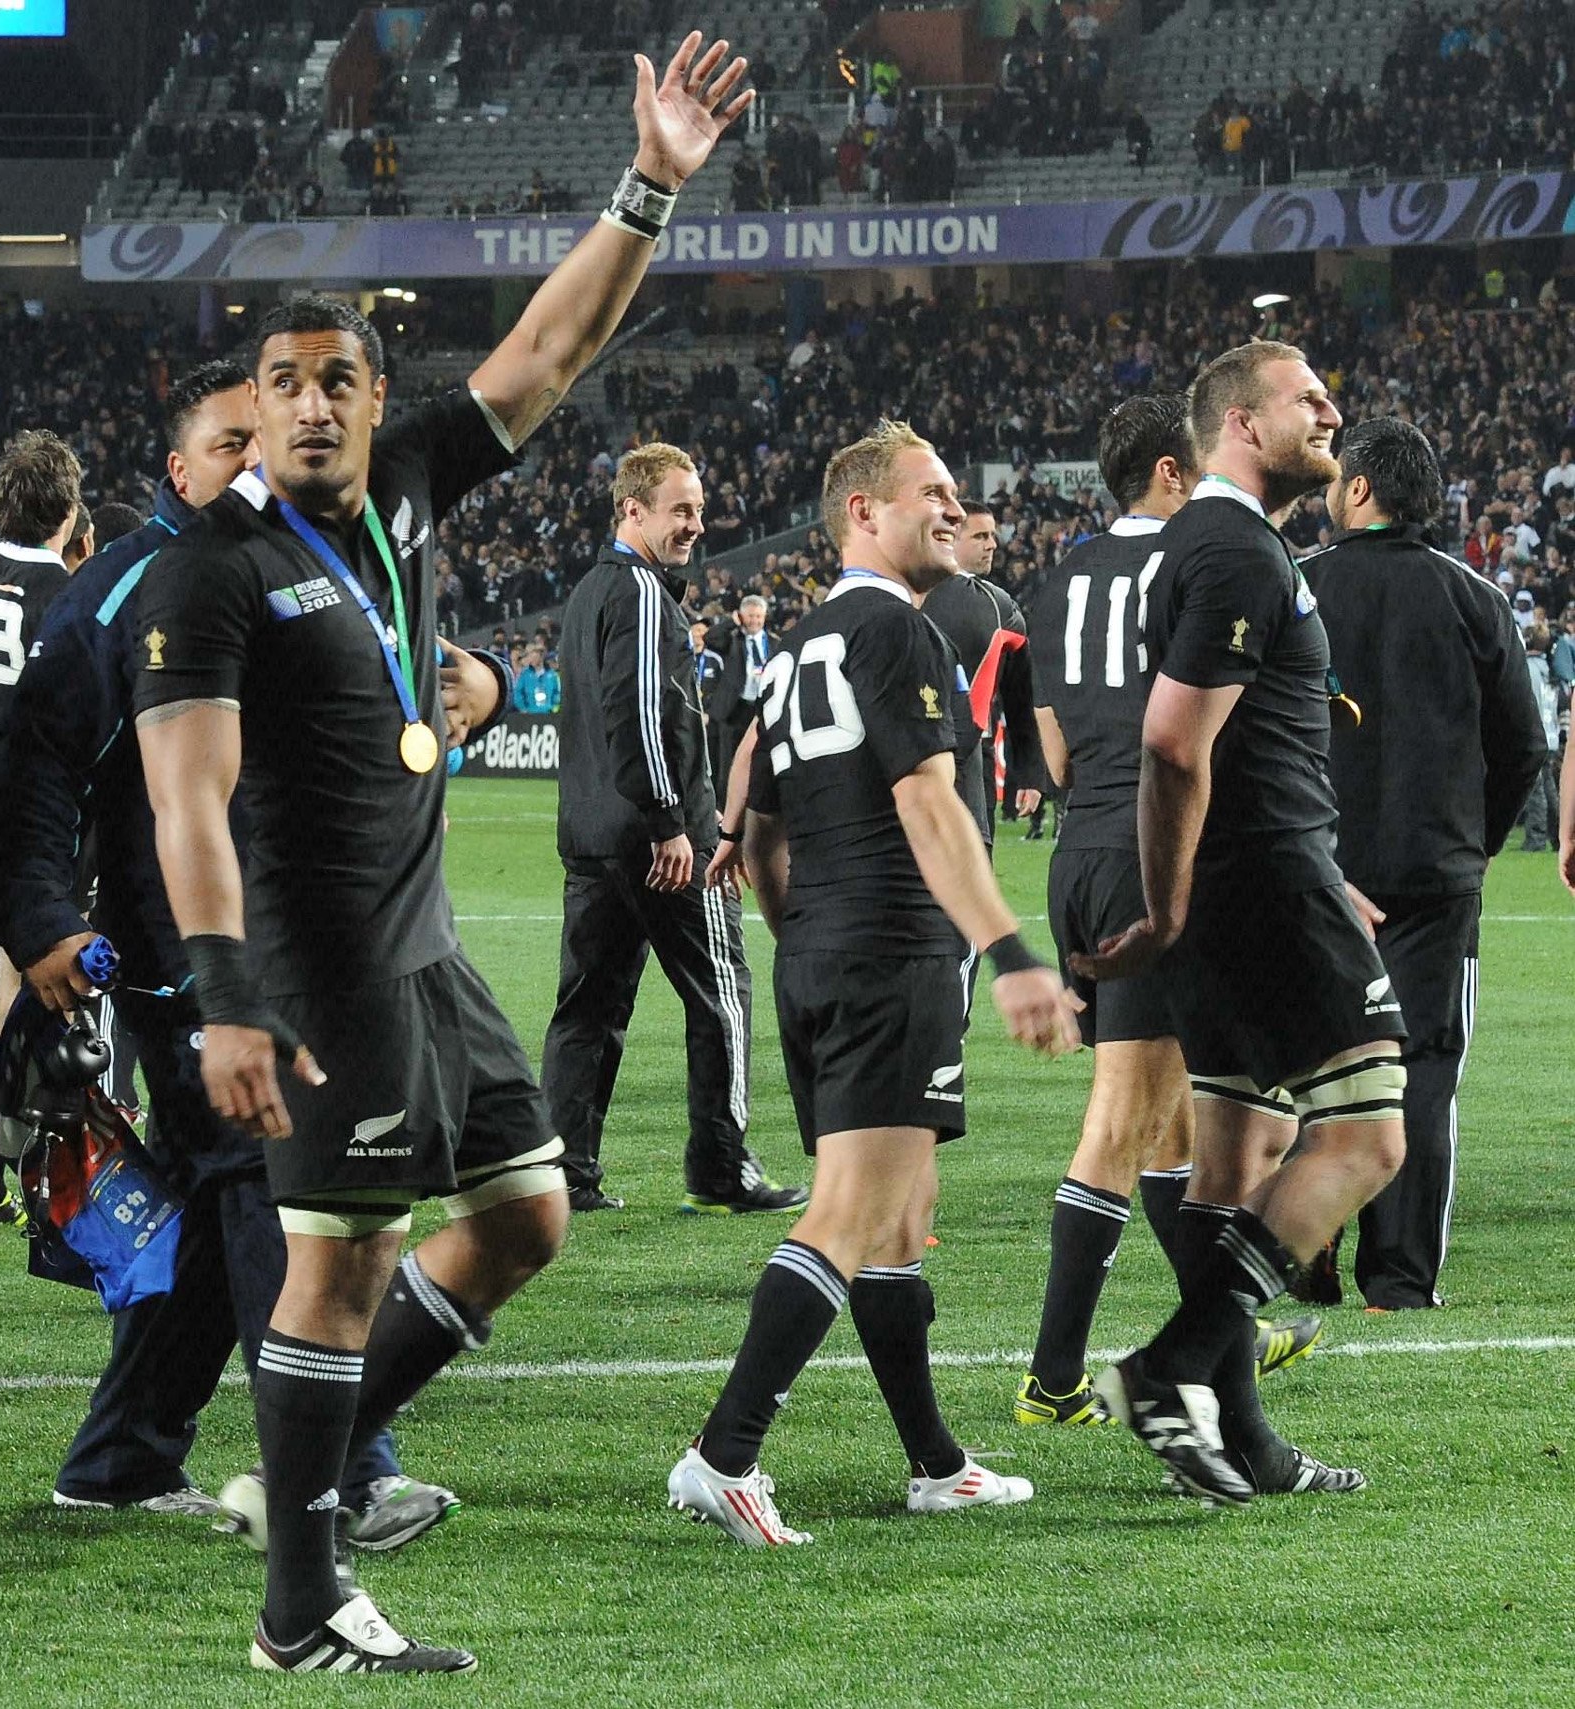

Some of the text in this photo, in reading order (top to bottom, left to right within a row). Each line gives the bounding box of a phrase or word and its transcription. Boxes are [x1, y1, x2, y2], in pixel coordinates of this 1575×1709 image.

[474, 226, 574, 265] THE
[784, 221, 834, 258] IN
[848, 215, 998, 257] UNION
[293, 576, 332, 596] RUGBY
[301, 593, 342, 614] 2011
[1064, 574, 1132, 688] 11
[759, 632, 867, 777] 20
[346, 1147, 413, 1157] ALL BLACKS
